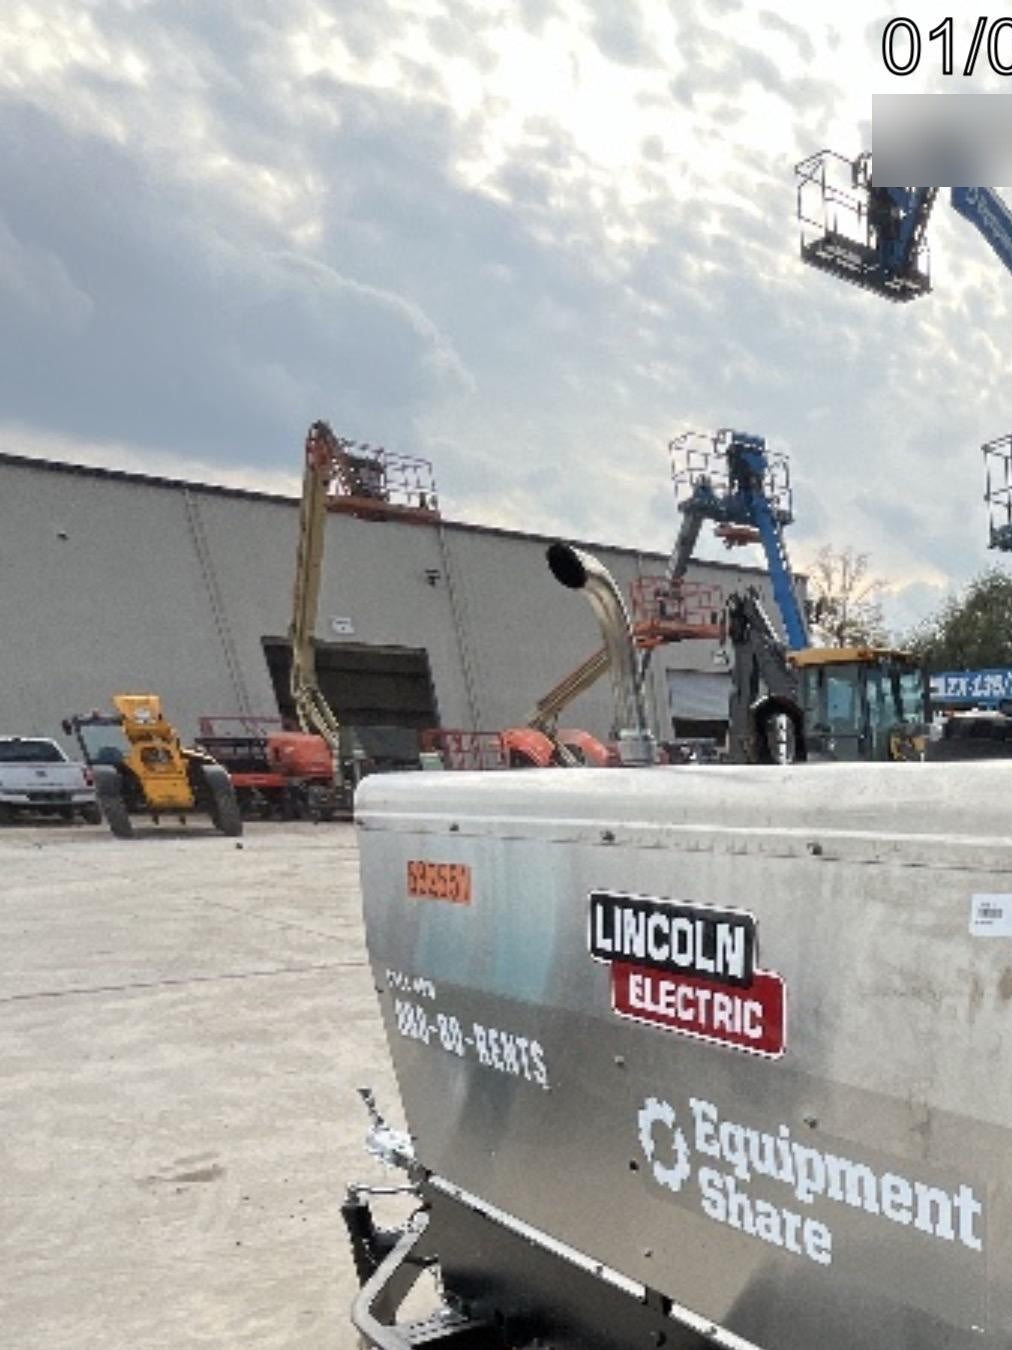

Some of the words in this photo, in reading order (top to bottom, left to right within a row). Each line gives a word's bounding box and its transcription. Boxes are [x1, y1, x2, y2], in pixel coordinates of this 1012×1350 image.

[596, 903, 745, 979] LINCOLN
[629, 973, 764, 1039] ELECTRIC
[689, 1097, 983, 1252] Equipment
[698, 1166, 833, 1266] Share
